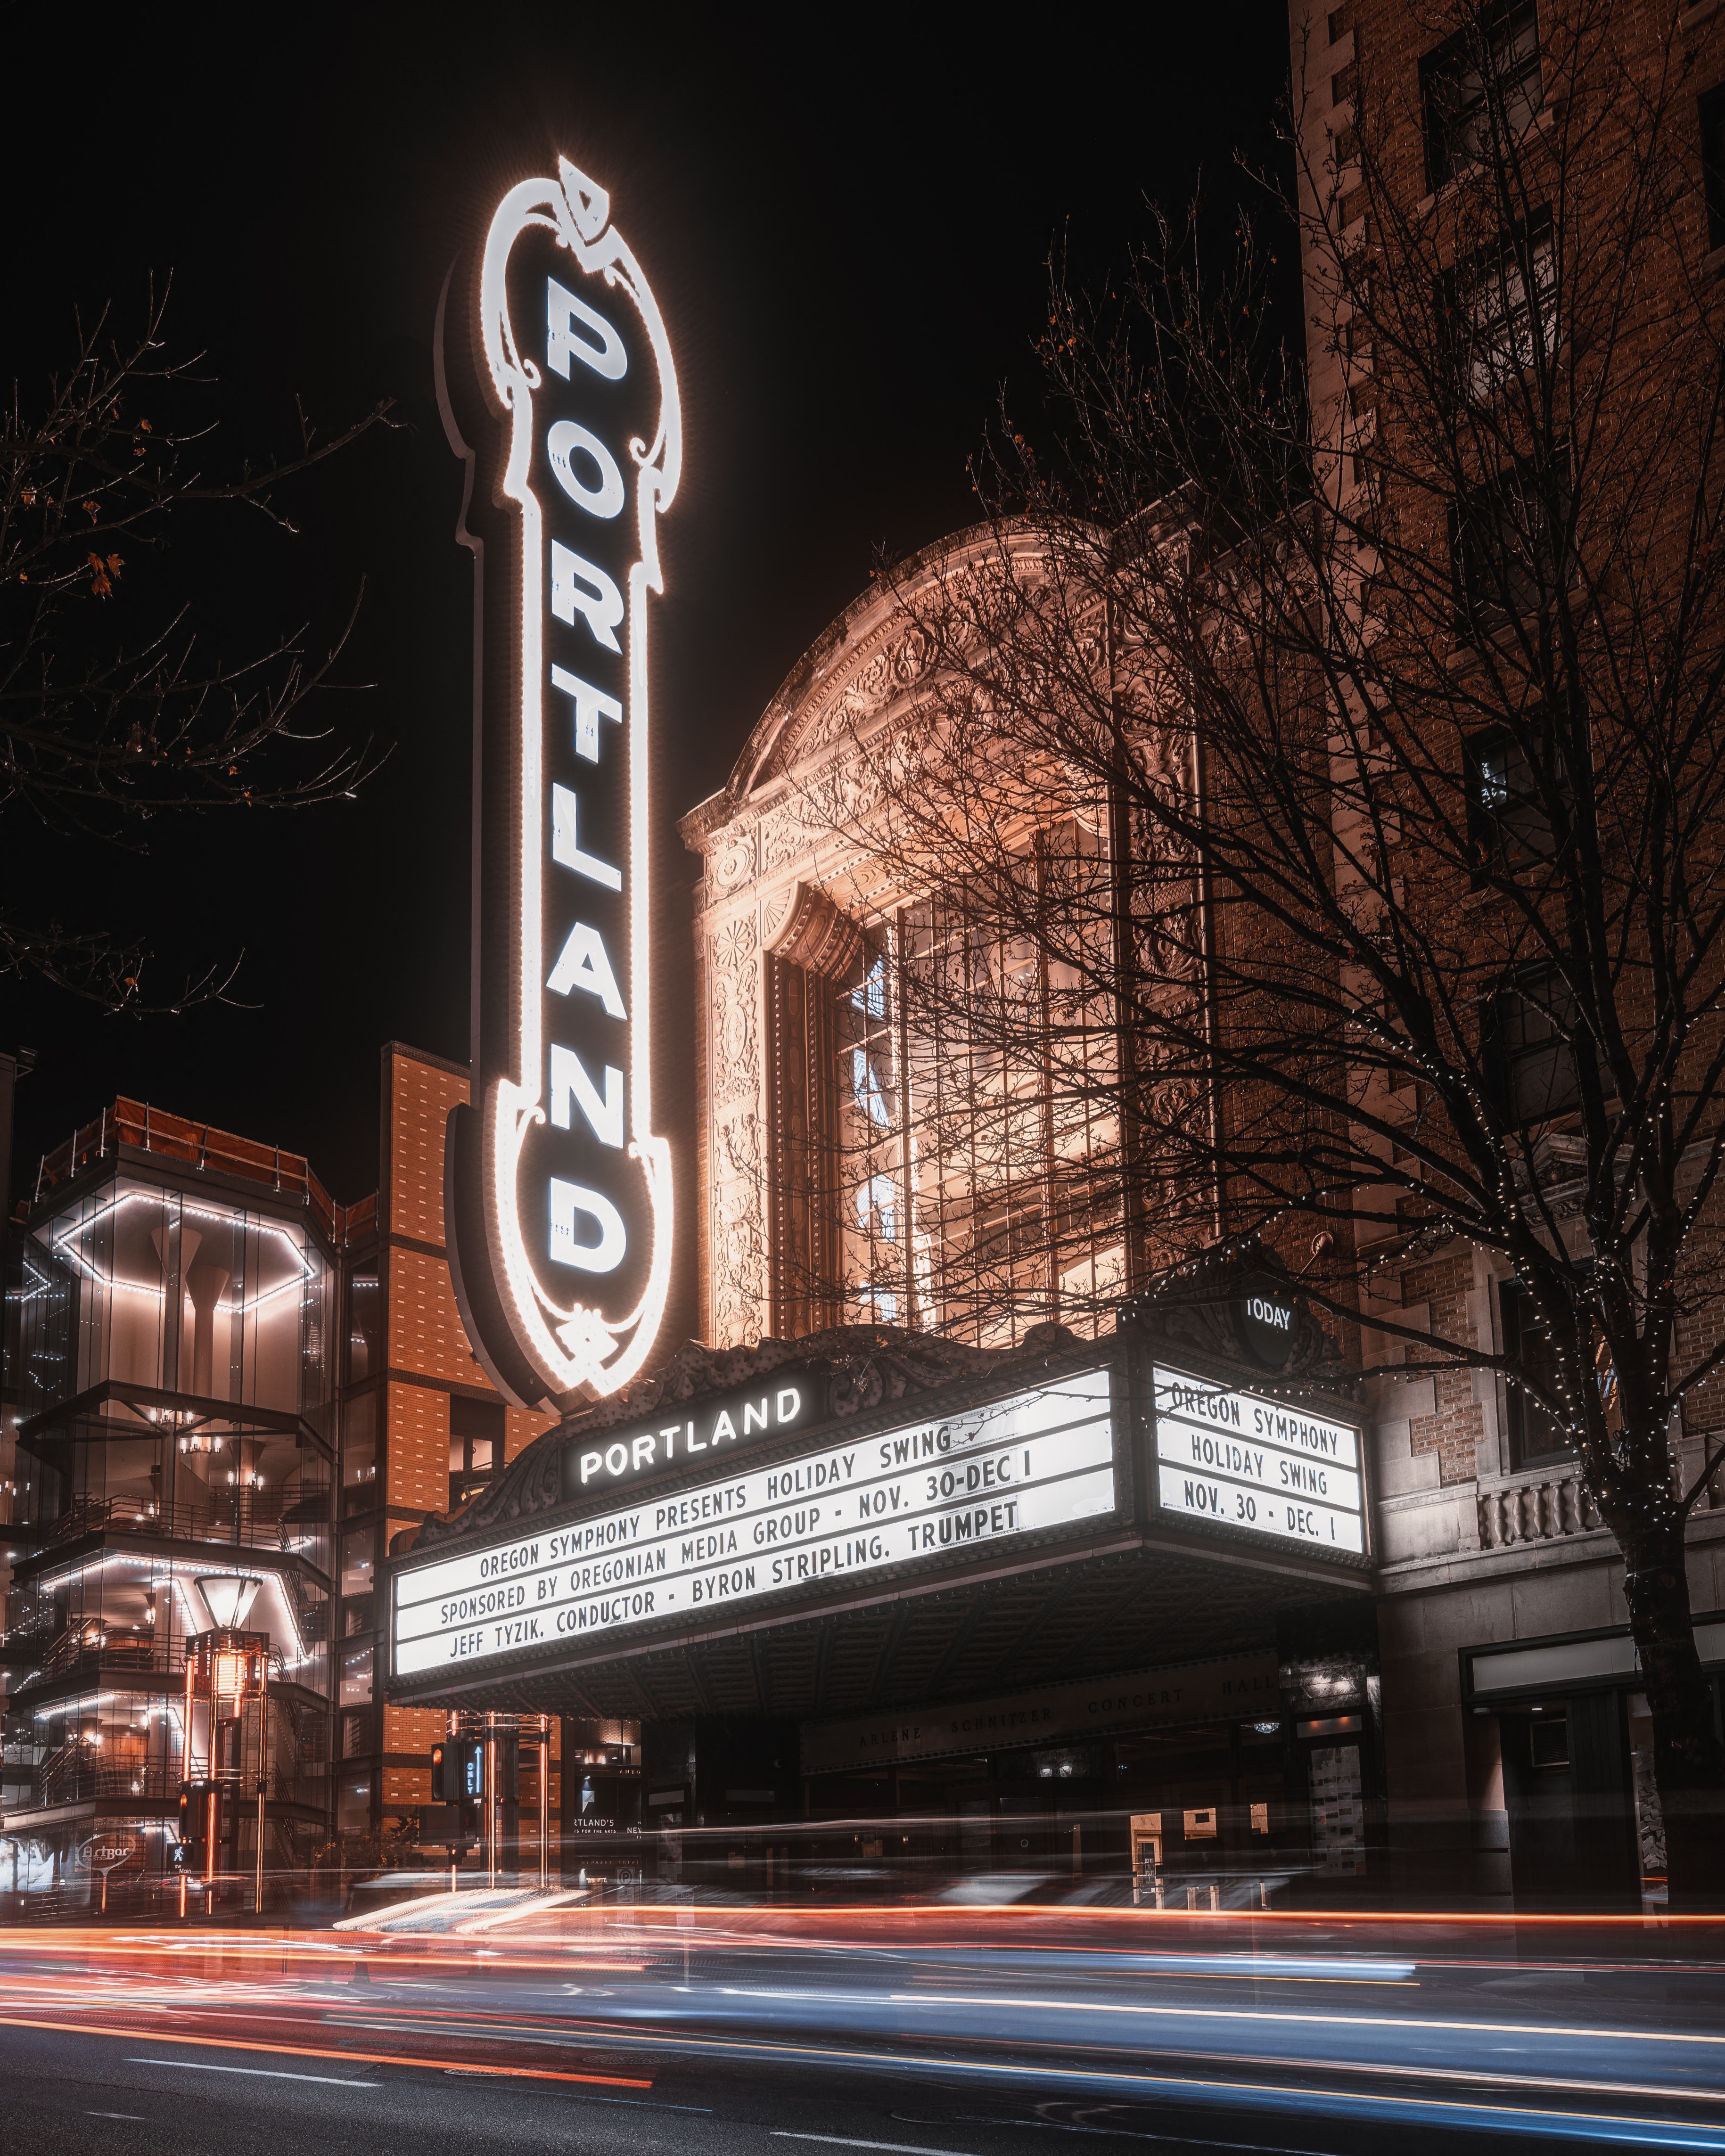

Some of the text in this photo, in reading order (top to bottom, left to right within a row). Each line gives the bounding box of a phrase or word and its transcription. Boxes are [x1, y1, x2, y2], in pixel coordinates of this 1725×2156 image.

[546, 276, 628, 1273] PORTLAND
[580, 1387, 801, 1484] PORTLAND
[1172, 1382, 1337, 1455] OREGON SYMPHONY
[1191, 1434, 1327, 1495] HOLIDAY SWING
[480, 1425, 951, 1578] OREGON SYMPHONY PRESENTS HOLIDAY SWING
[1184, 1480, 1224, 1515] NOV.
[1237, 1493, 1256, 1522] 30
[1287, 1506, 1319, 1536] DEC.
[441, 1586, 525, 1624] SPONSORED
[538, 1576, 558, 1600] BY
[570, 1548, 665, 1591] OREGONIAN
[682, 1530, 737, 1564] MEDIA
[753, 1508, 820, 1545] GROUP
[859, 1485, 909, 1518] NOV.
[450, 1631, 483, 1657] JEFF
[557, 1591, 655, 1632] CONDUCTOR
[693, 1566, 755, 1603] BYRON
[908, 1500, 1017, 1551] TRUMPET
[859, 1675, 1274, 1747] ARLENE SCHNITZER CONCERT HALL
